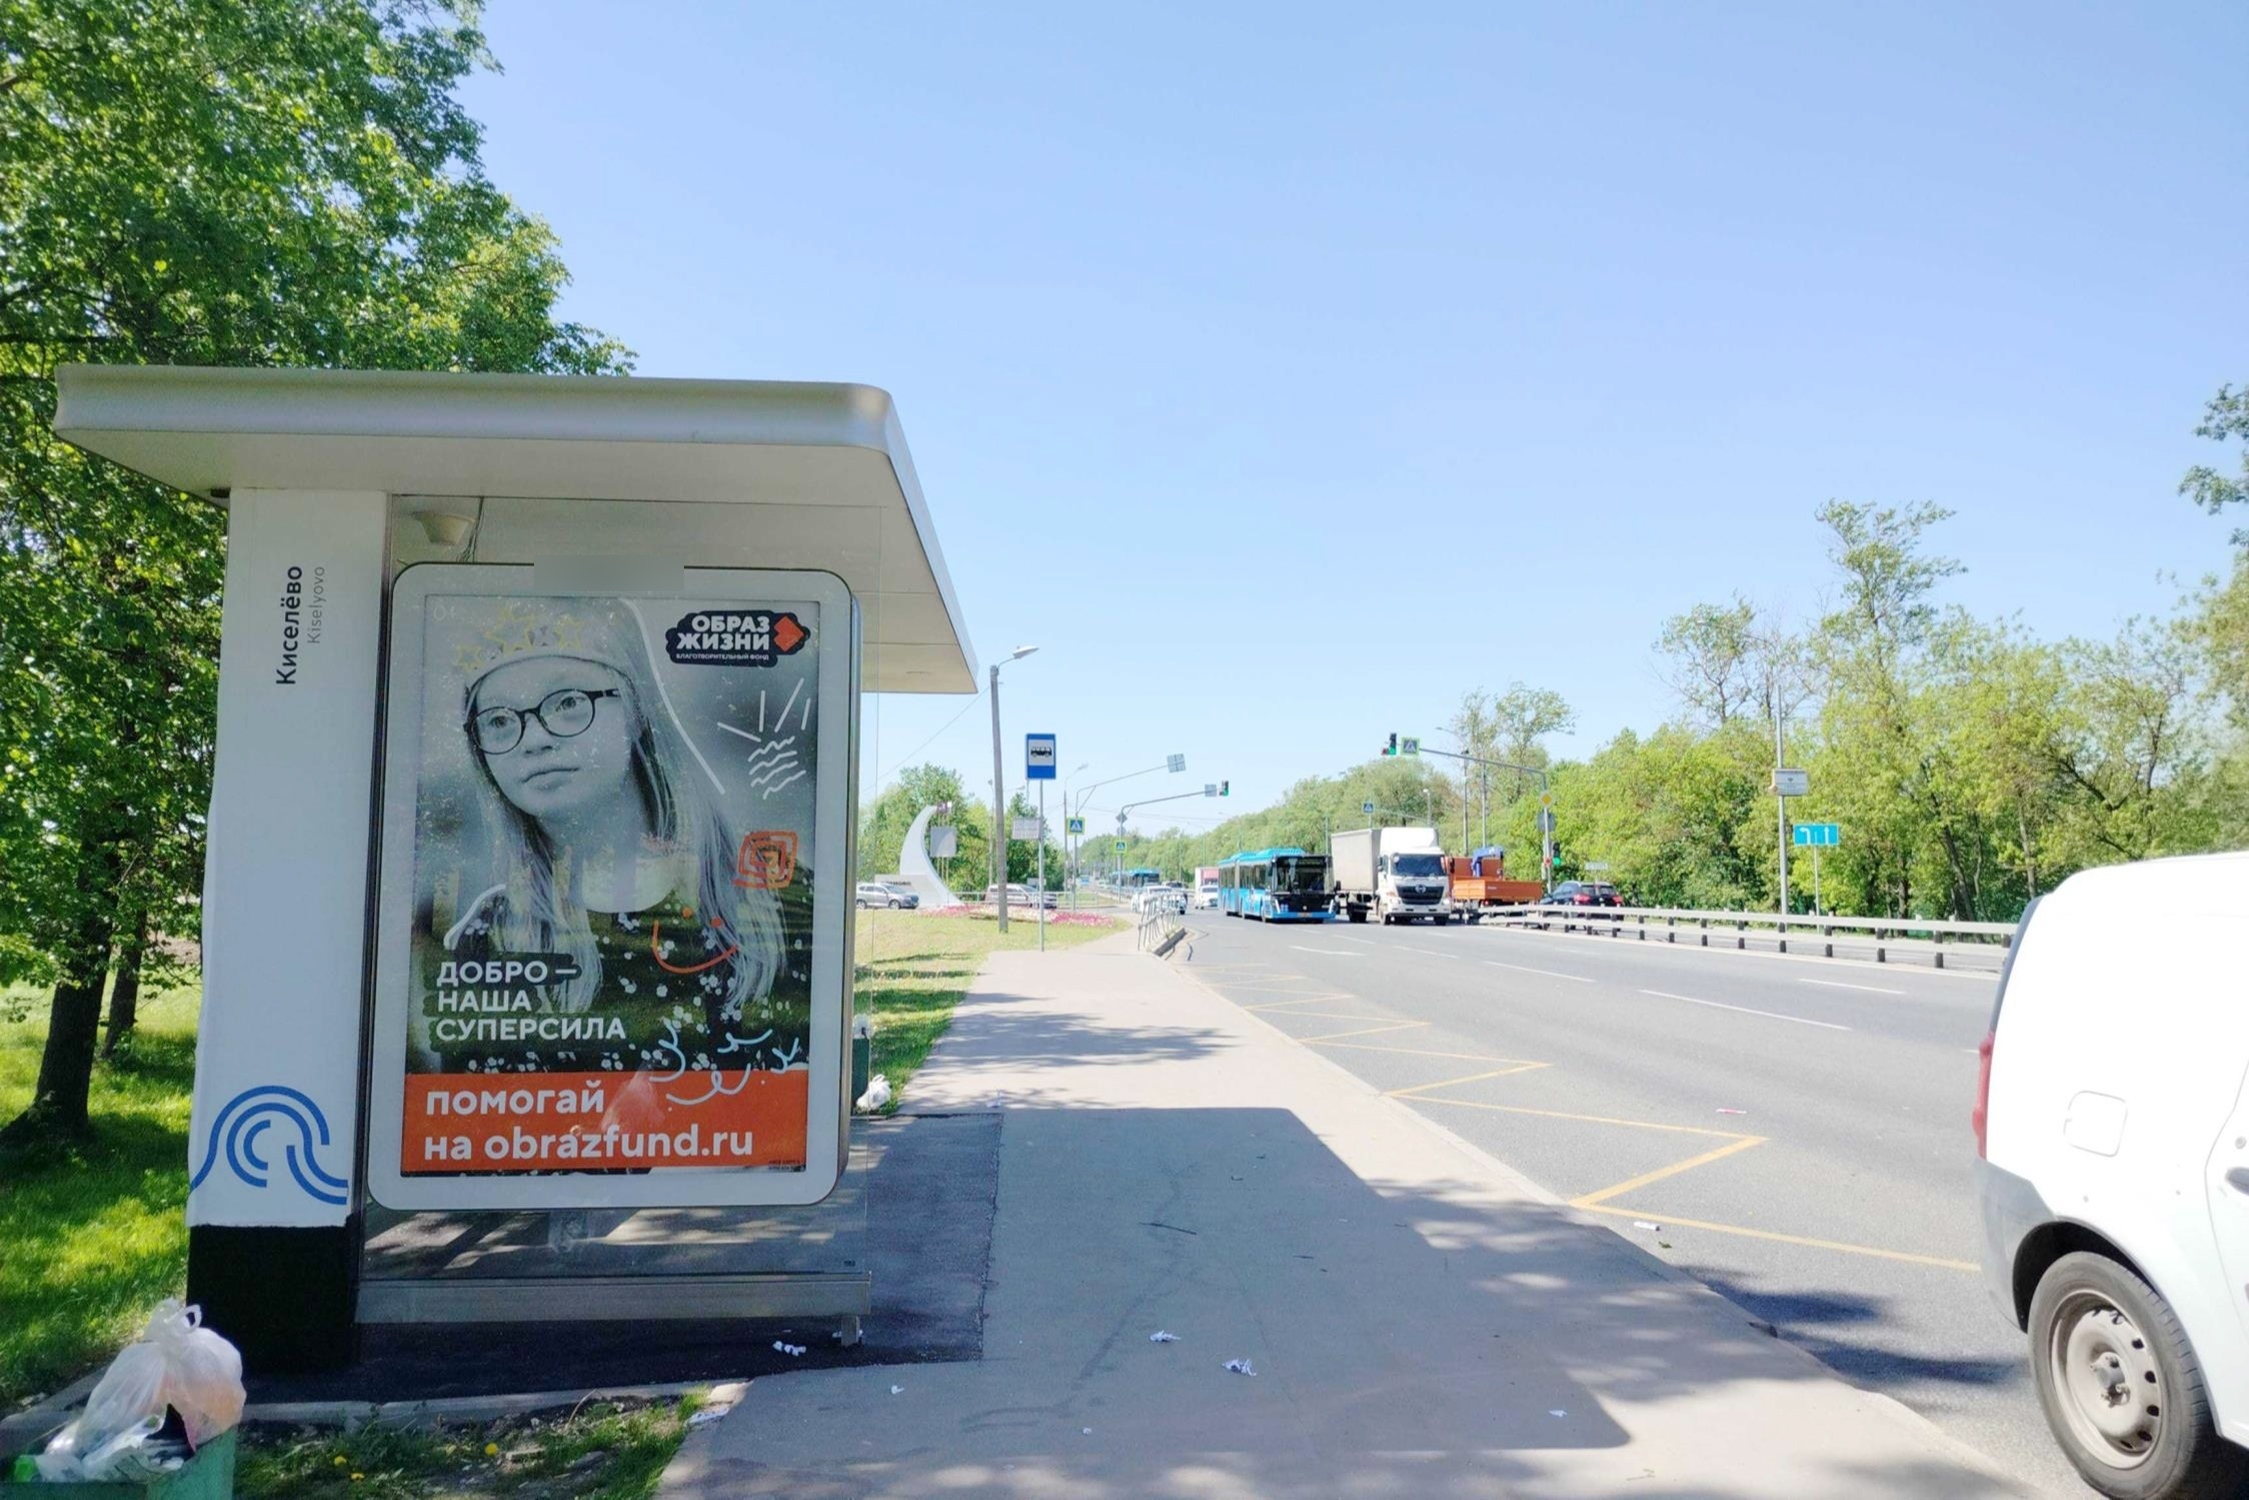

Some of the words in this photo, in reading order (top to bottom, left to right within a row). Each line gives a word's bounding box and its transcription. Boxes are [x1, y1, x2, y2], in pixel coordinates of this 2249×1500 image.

[307, 566, 327, 644] Kiselyovo
[276, 566, 303, 684] Киселёво
[691, 615, 770, 633] ОБРАЗ
[676, 633, 770, 650] ЖИЗНИ
[436, 960, 548, 987] ДОБРО
[438, 990, 532, 1012] НАША
[435, 1017, 626, 1041] СУПЕРСИЛА
[426, 1080, 605, 1116] помогай
[424, 1135, 472, 1160] на
[485, 1124, 753, 1160] obrazfund.ru
